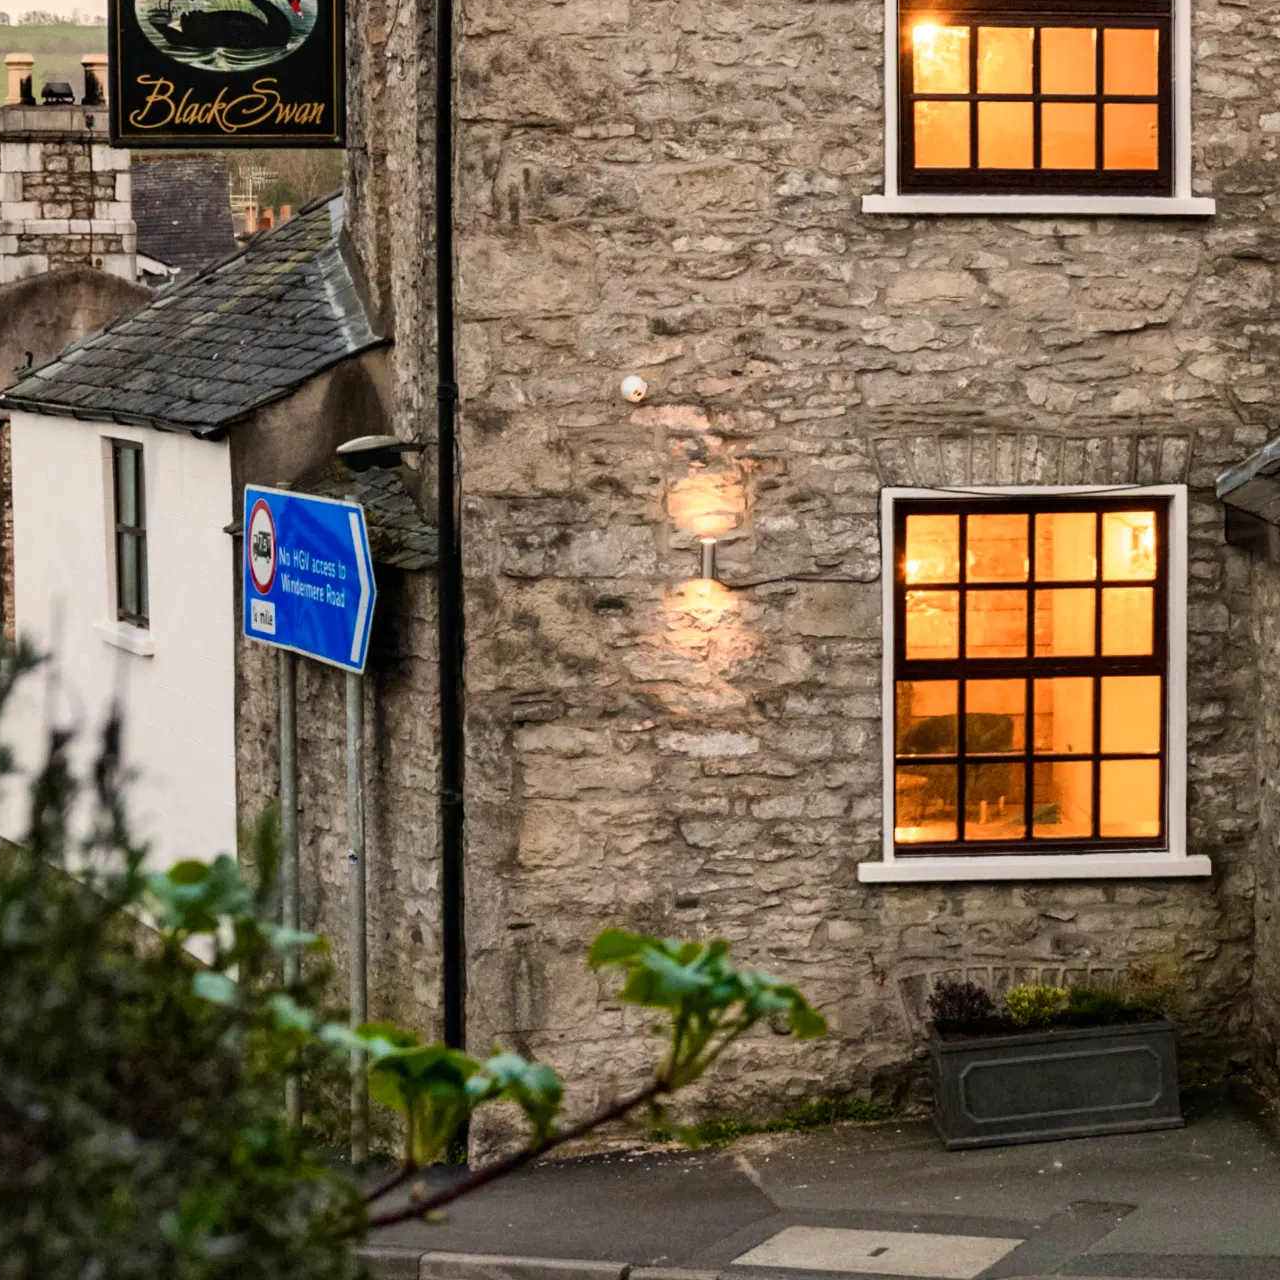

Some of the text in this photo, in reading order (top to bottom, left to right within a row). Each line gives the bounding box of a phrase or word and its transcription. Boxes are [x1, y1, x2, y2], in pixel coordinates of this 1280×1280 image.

[129, 74, 325, 132] Black Swan
[278, 546, 346, 580] No HGV access to
[280, 573, 346, 608] Windermere Road
[260, 609, 273, 626] mile
